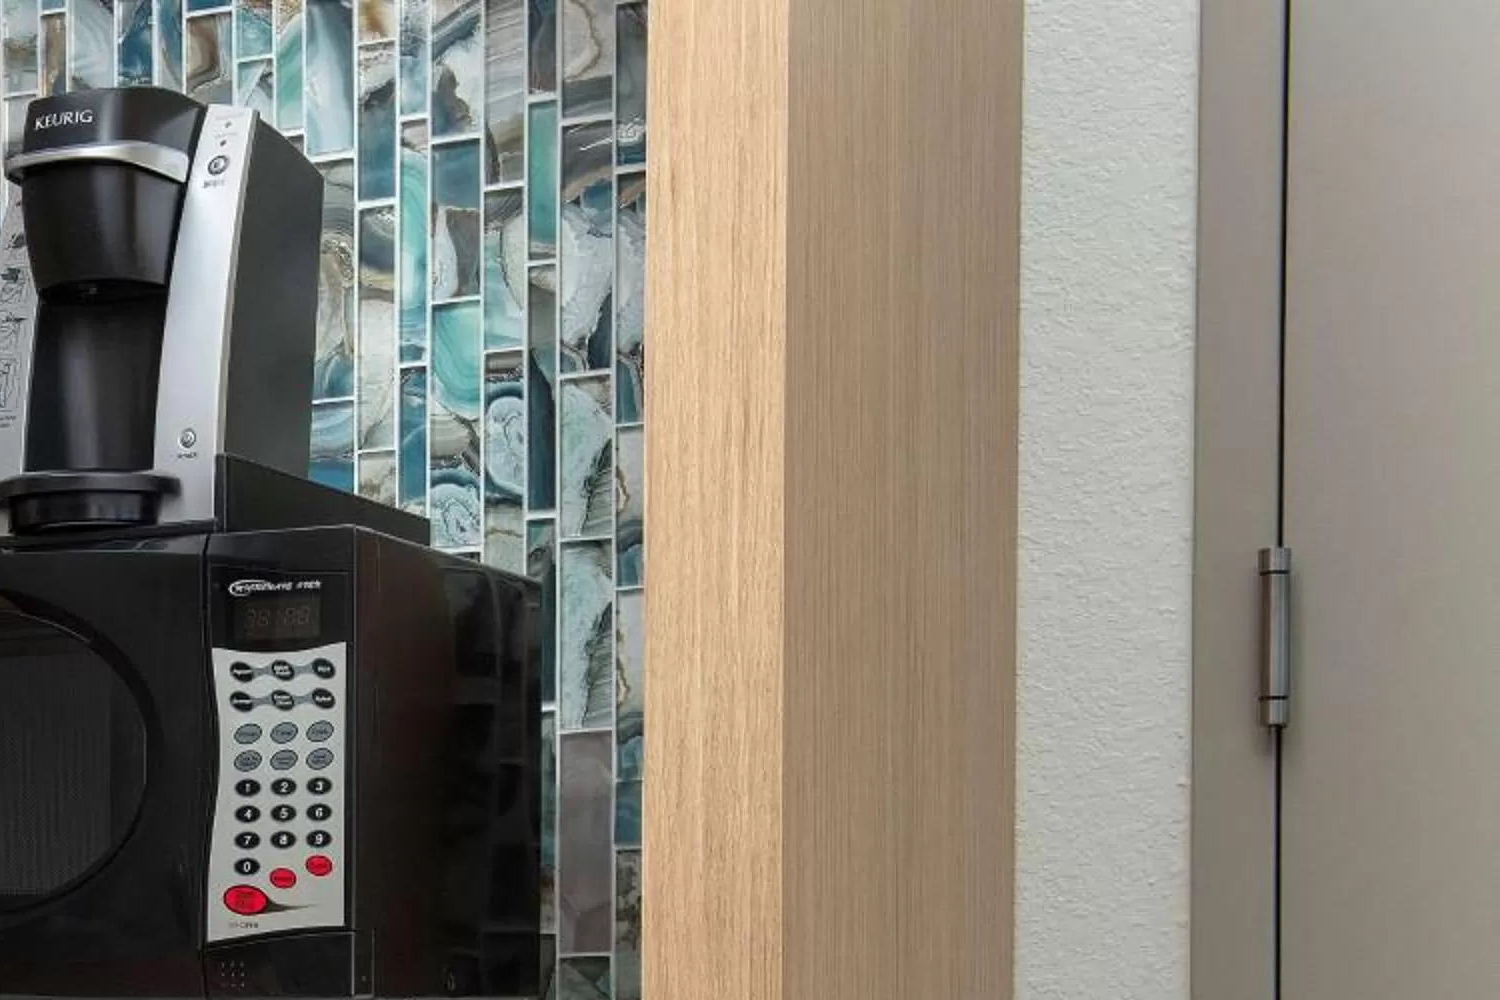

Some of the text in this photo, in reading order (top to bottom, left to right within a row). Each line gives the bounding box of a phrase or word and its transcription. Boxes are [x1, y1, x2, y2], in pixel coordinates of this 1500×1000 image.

[35, 109, 93, 130] KEURIG
[245, 781, 324, 793] 1 2 3
[243, 807, 323, 820] 4 5 6
[243, 834, 324, 846] 7 8 9
[243, 861, 252, 873] 0
